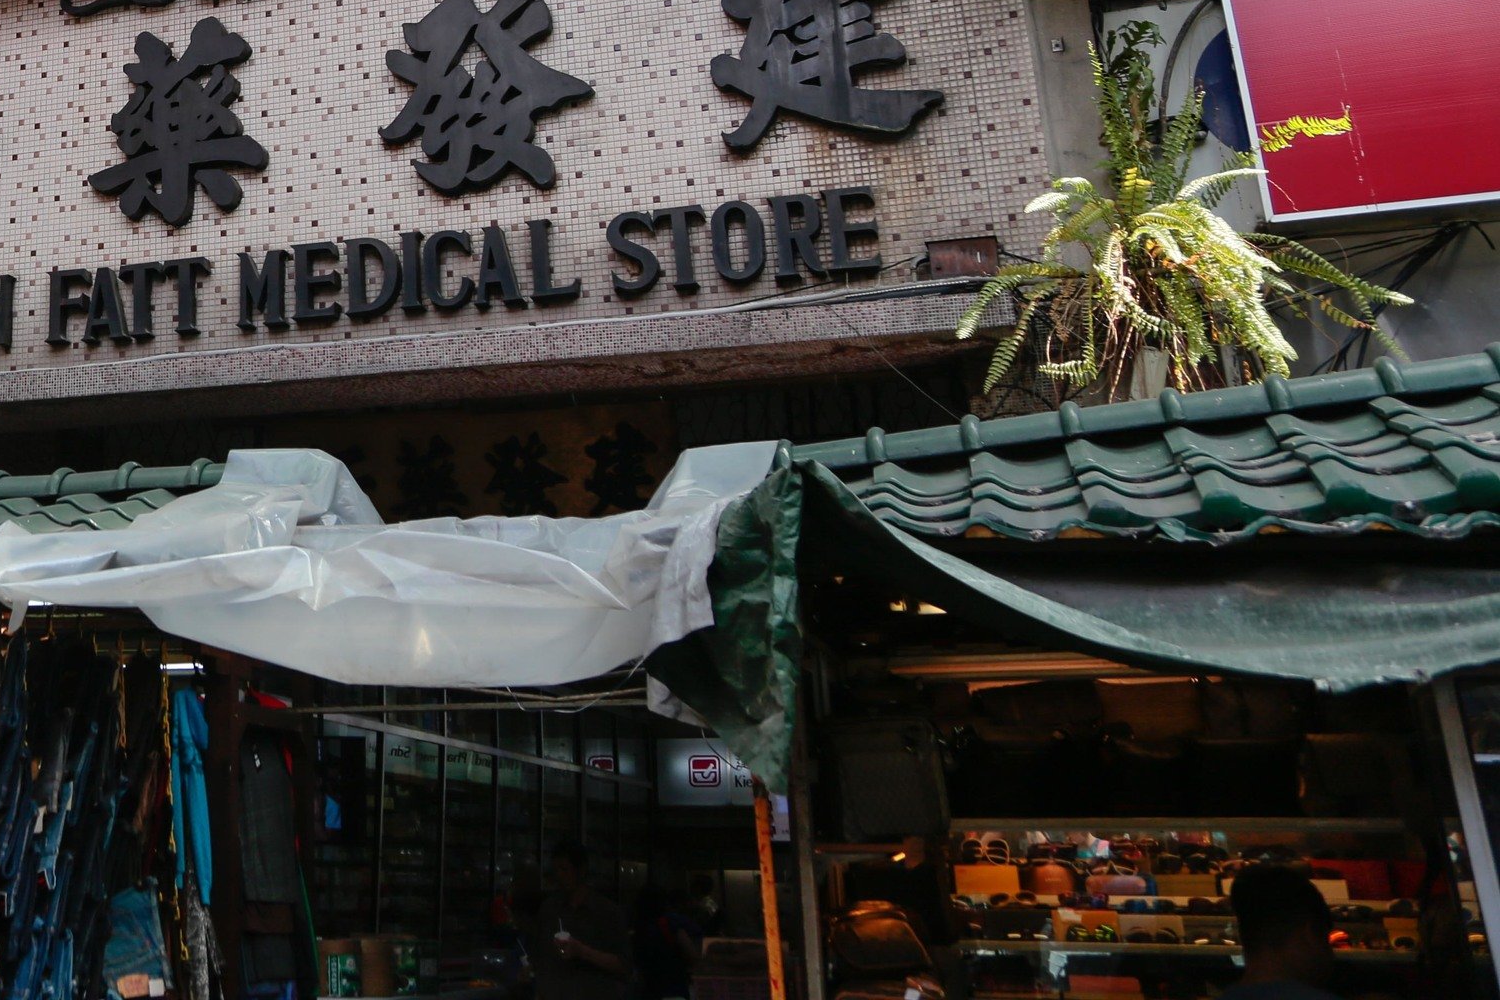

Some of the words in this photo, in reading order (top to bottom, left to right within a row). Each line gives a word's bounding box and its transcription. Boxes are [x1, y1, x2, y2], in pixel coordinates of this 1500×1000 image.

[45, 256, 212, 347] FATT
[236, 218, 581, 333] MEDICAL
[605, 184, 883, 298] STORE
